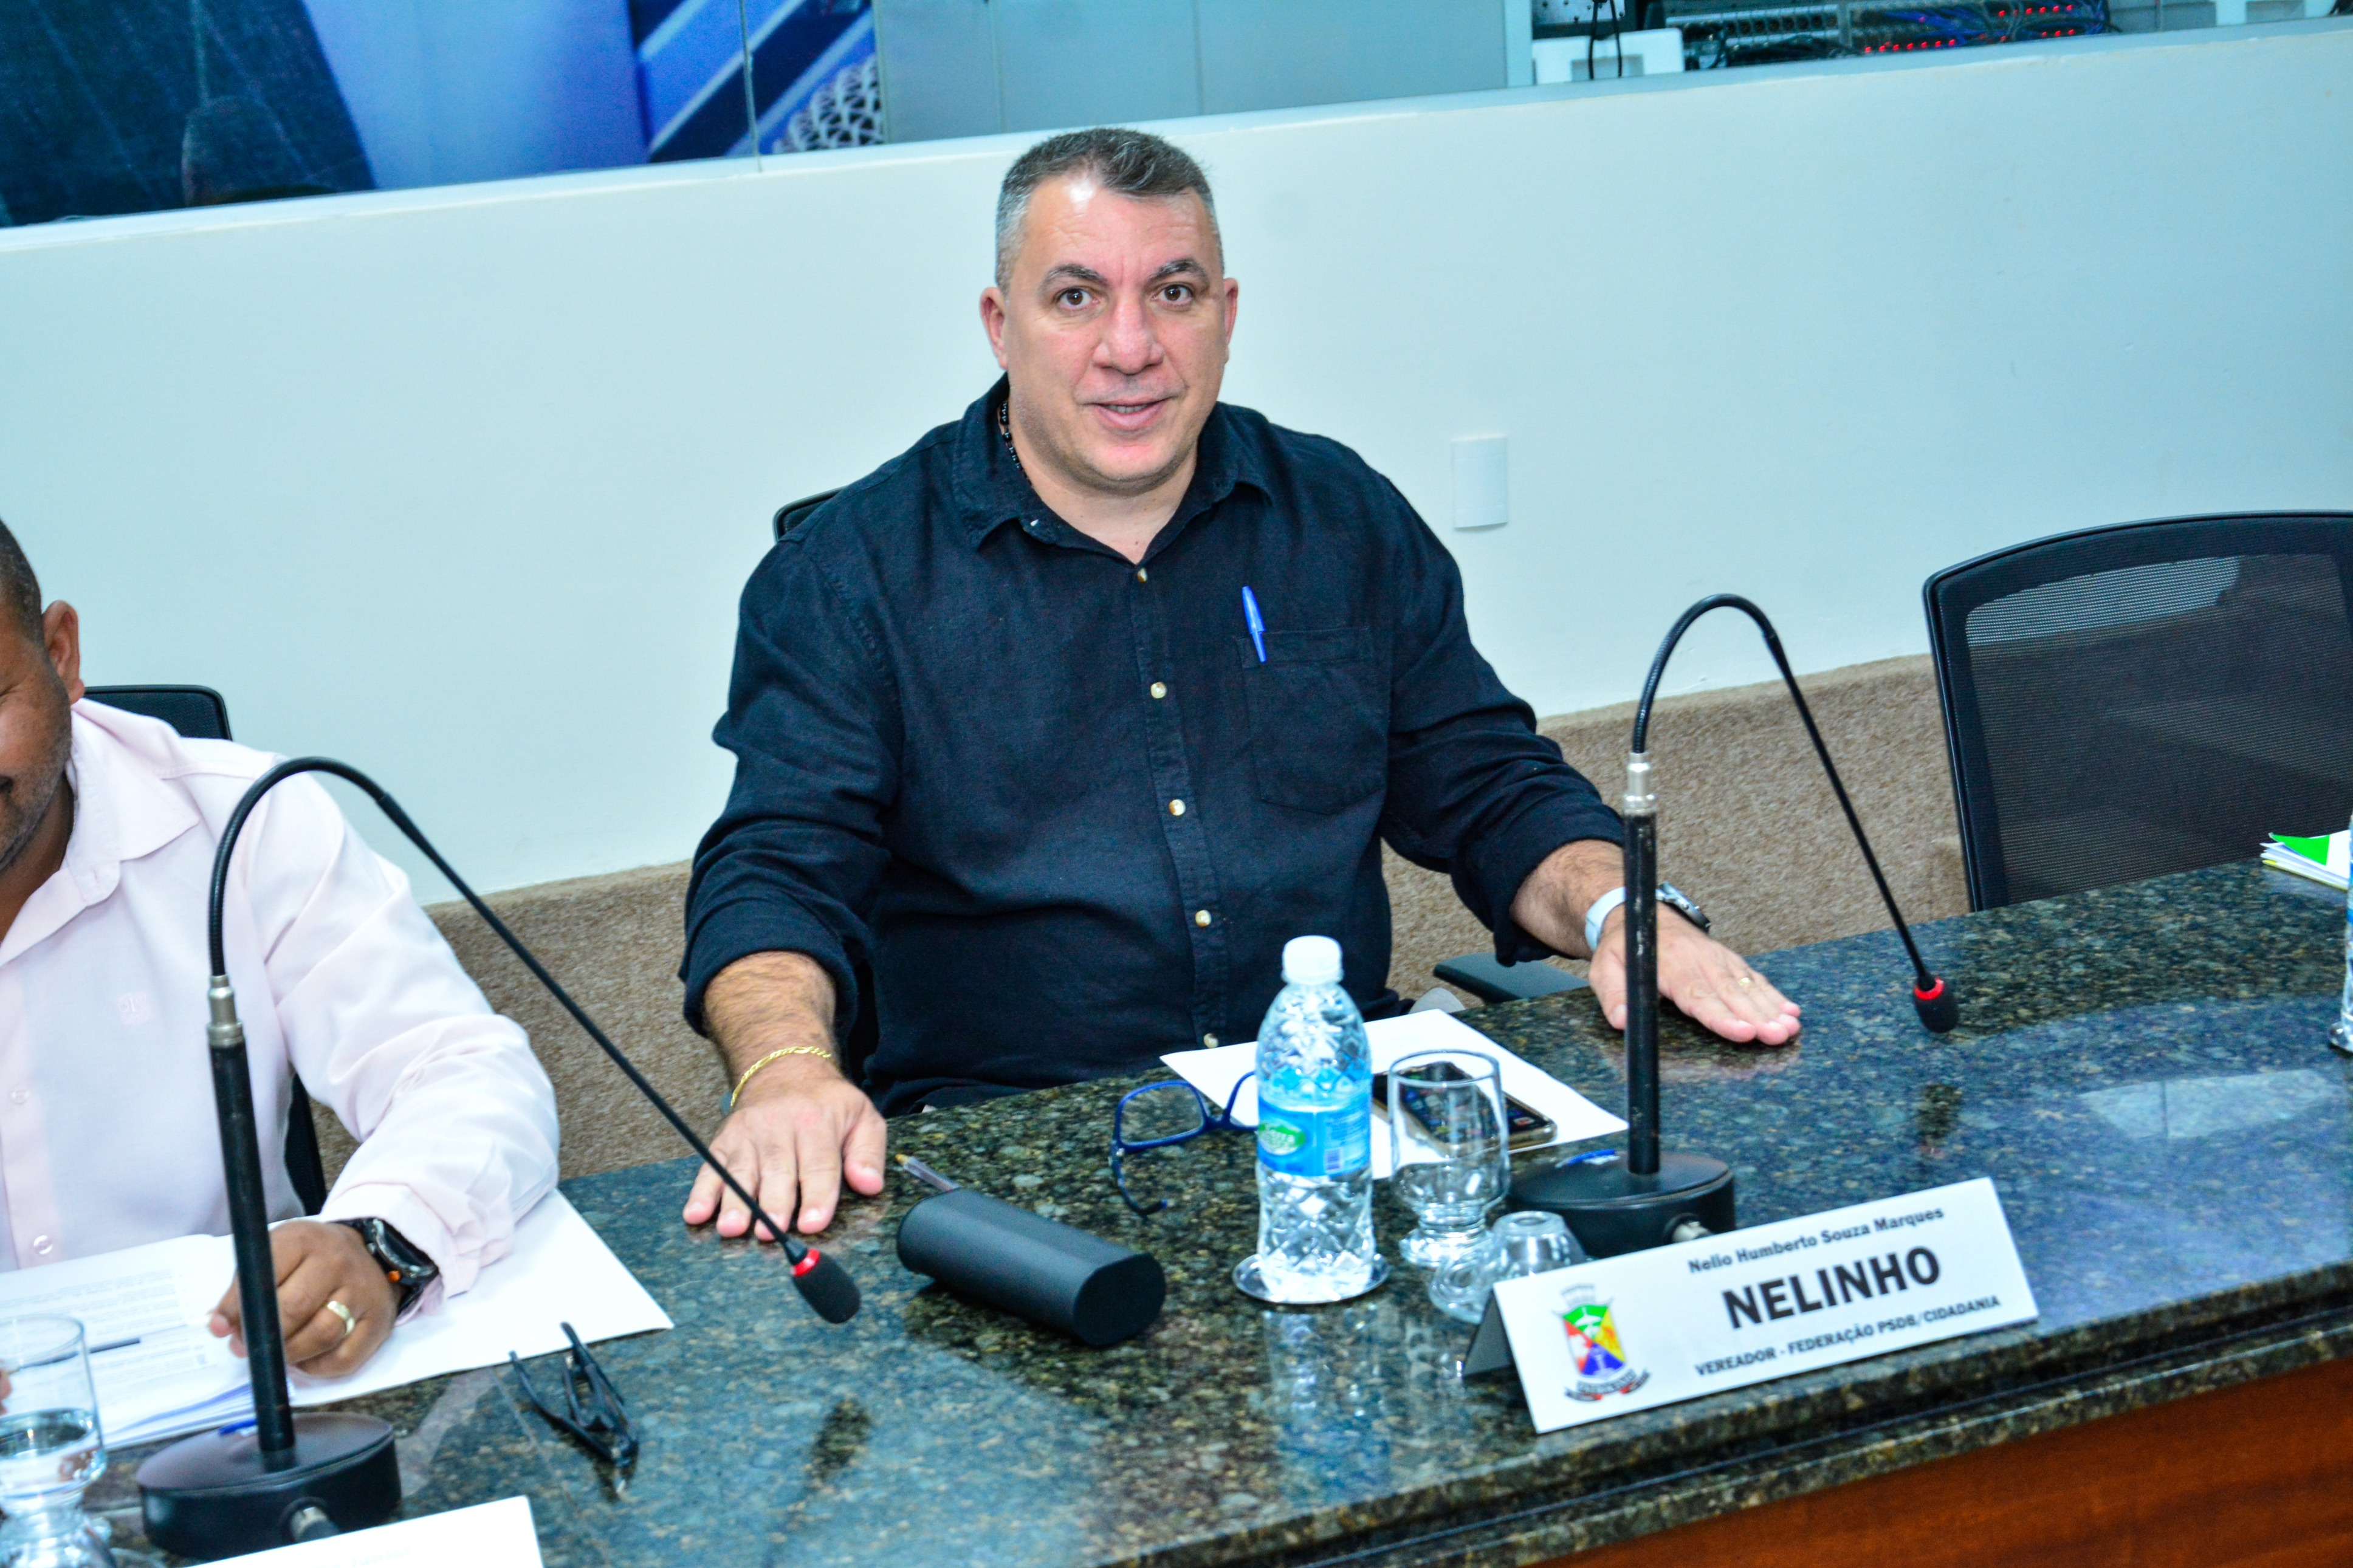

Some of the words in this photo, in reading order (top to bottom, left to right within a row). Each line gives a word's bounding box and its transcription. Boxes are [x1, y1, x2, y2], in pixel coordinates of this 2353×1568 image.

[1736, 1237, 1818, 1262] Humberto
[1821, 1225, 1870, 1244] Souza
[1874, 1209, 1944, 1231] Marques
[1722, 1246, 1941, 1330] NELINHO
[1695, 1347, 1777, 1376] VEREADOR
[1788, 1324, 1874, 1354] FEDERAÇÃO
[1877, 1296, 2001, 1333] PSDB/CIDADANIA
